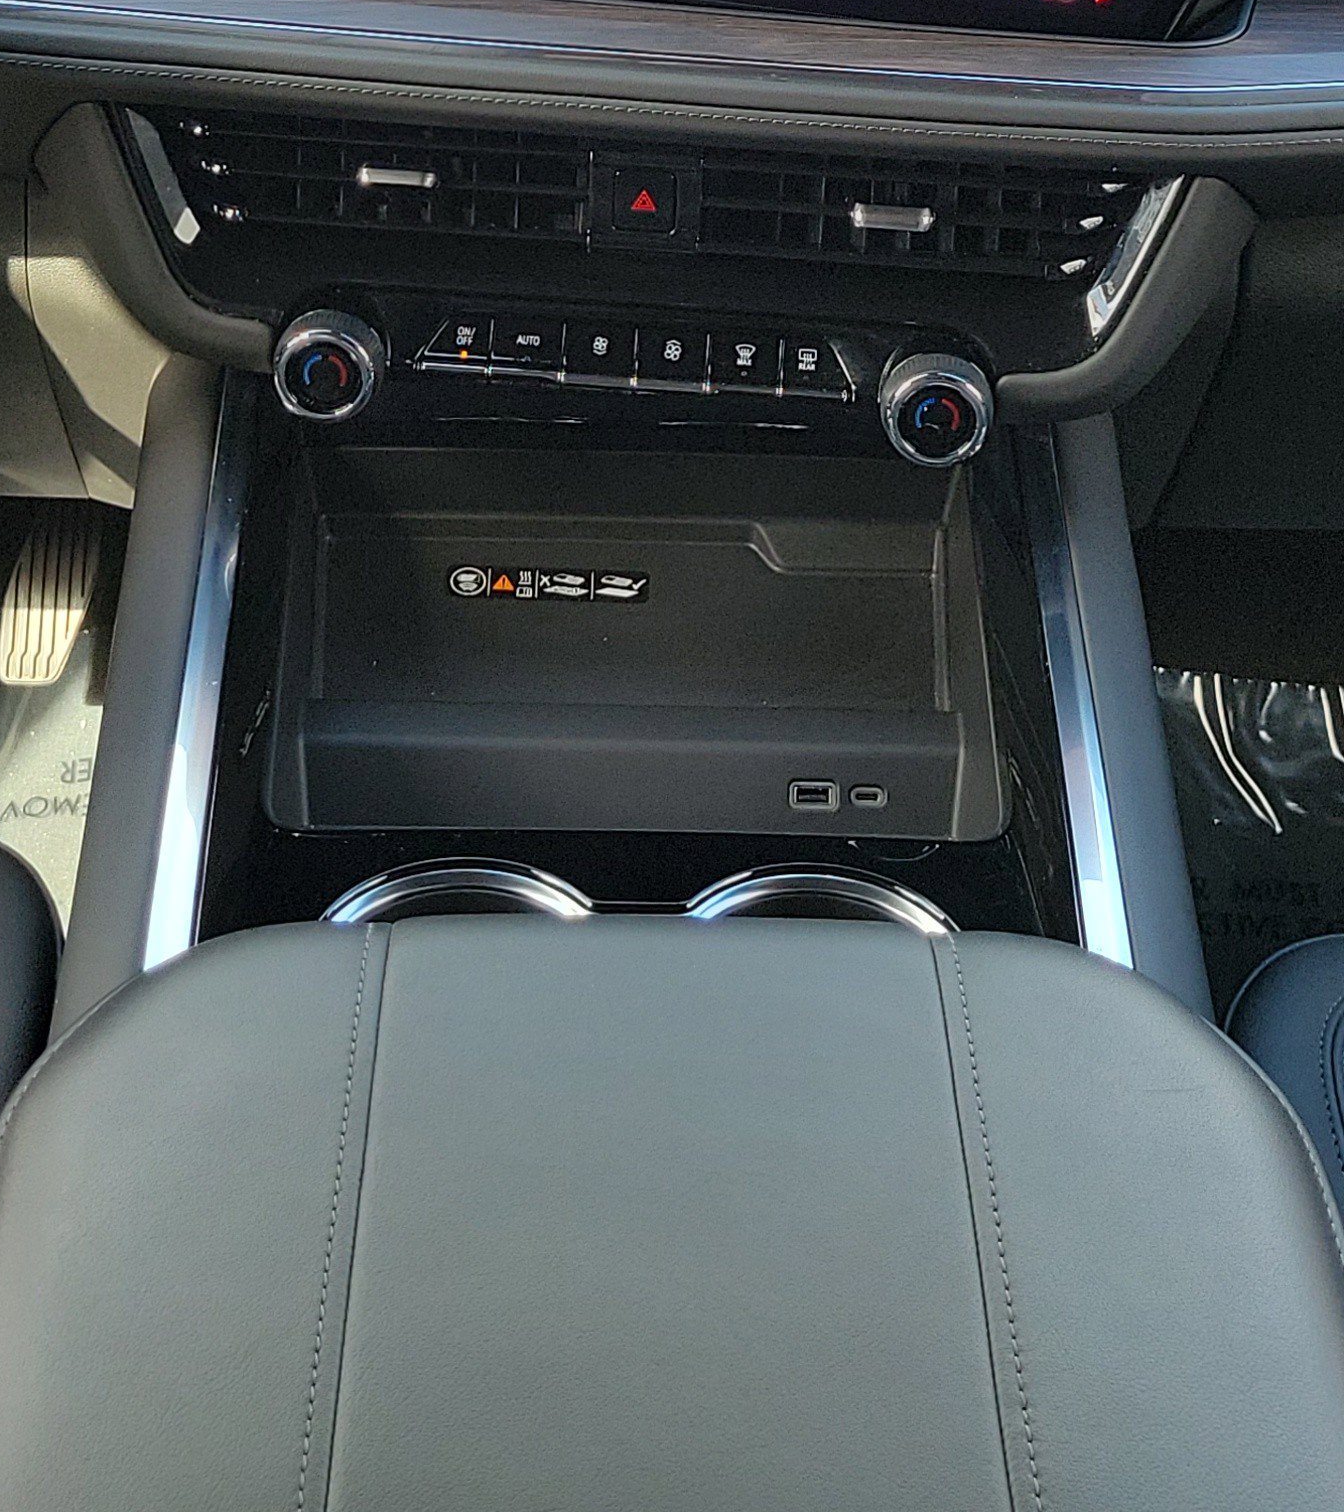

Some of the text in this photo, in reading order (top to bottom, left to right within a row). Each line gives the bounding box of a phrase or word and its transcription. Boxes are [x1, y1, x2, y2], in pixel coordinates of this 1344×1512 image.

[457, 326, 476, 338] ON/
[456, 336, 474, 347] OFF
[516, 334, 541, 347] AUTO
